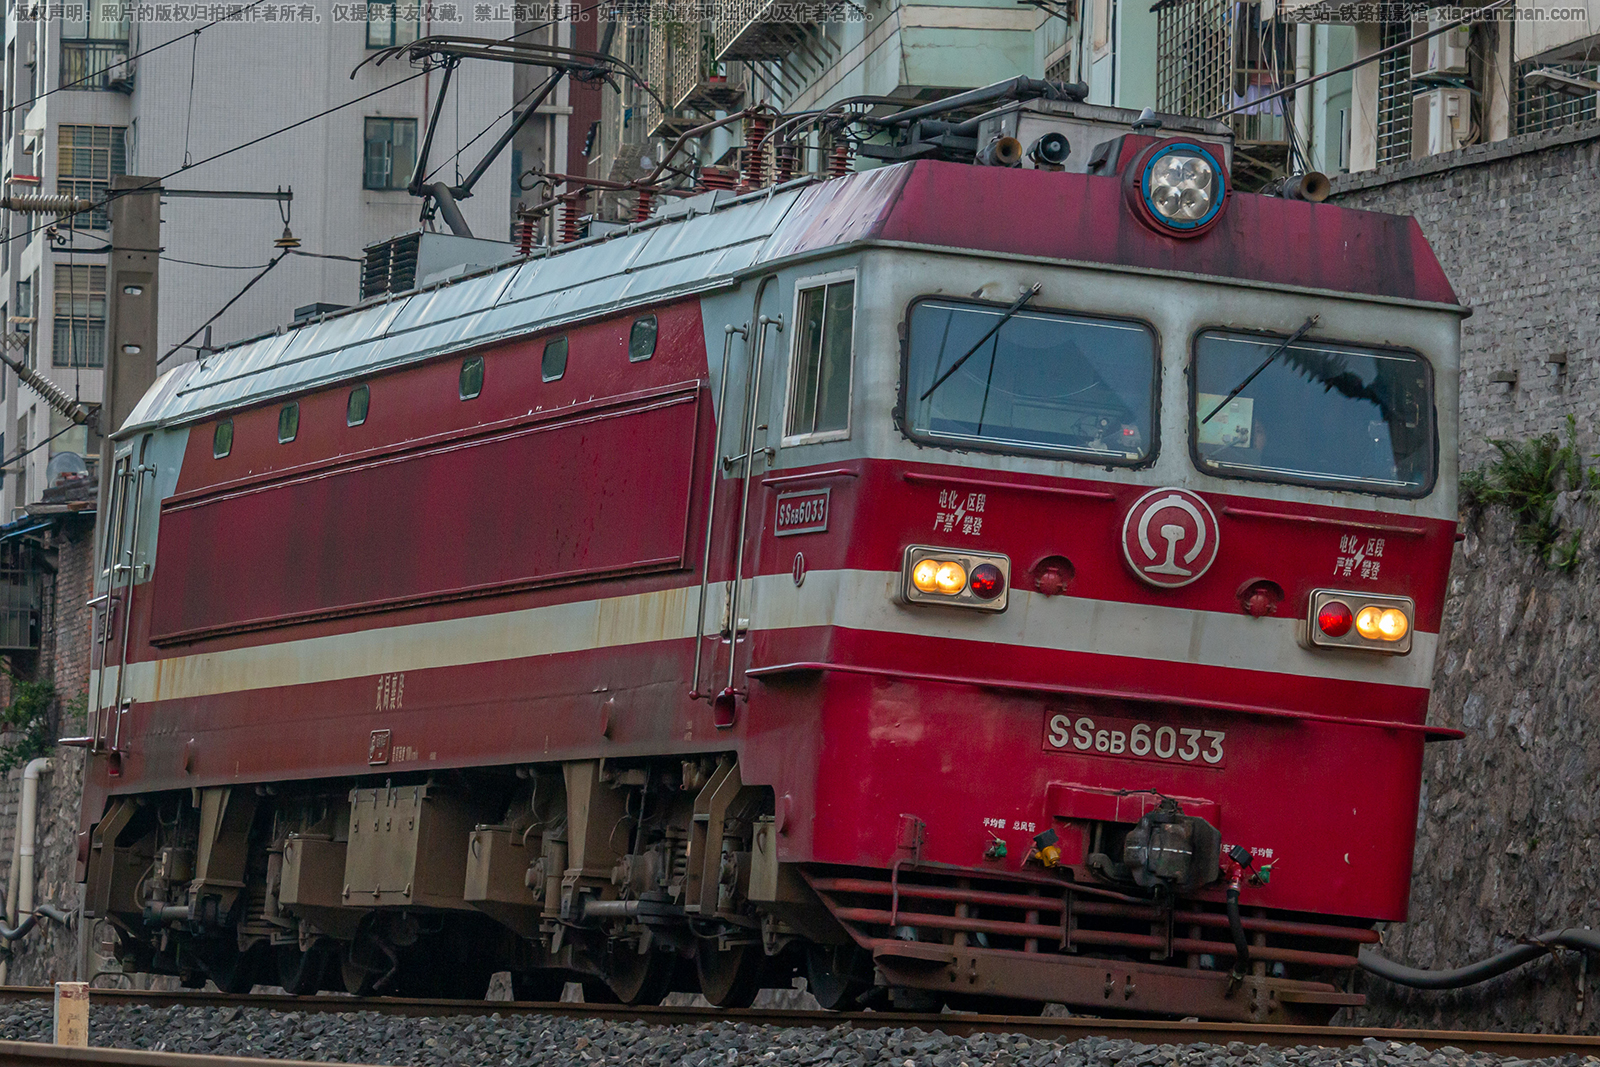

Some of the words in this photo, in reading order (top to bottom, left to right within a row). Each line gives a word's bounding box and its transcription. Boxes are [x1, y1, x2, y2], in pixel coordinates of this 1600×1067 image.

[779, 499, 825, 526] SS6B6033
[967, 493, 986, 512] 区段
[933, 512, 955, 533] 严禁
[1333, 556, 1354, 577] 严禁
[1048, 714, 1225, 764] SS6B6033
[1013, 820, 1036, 832] 总风管
